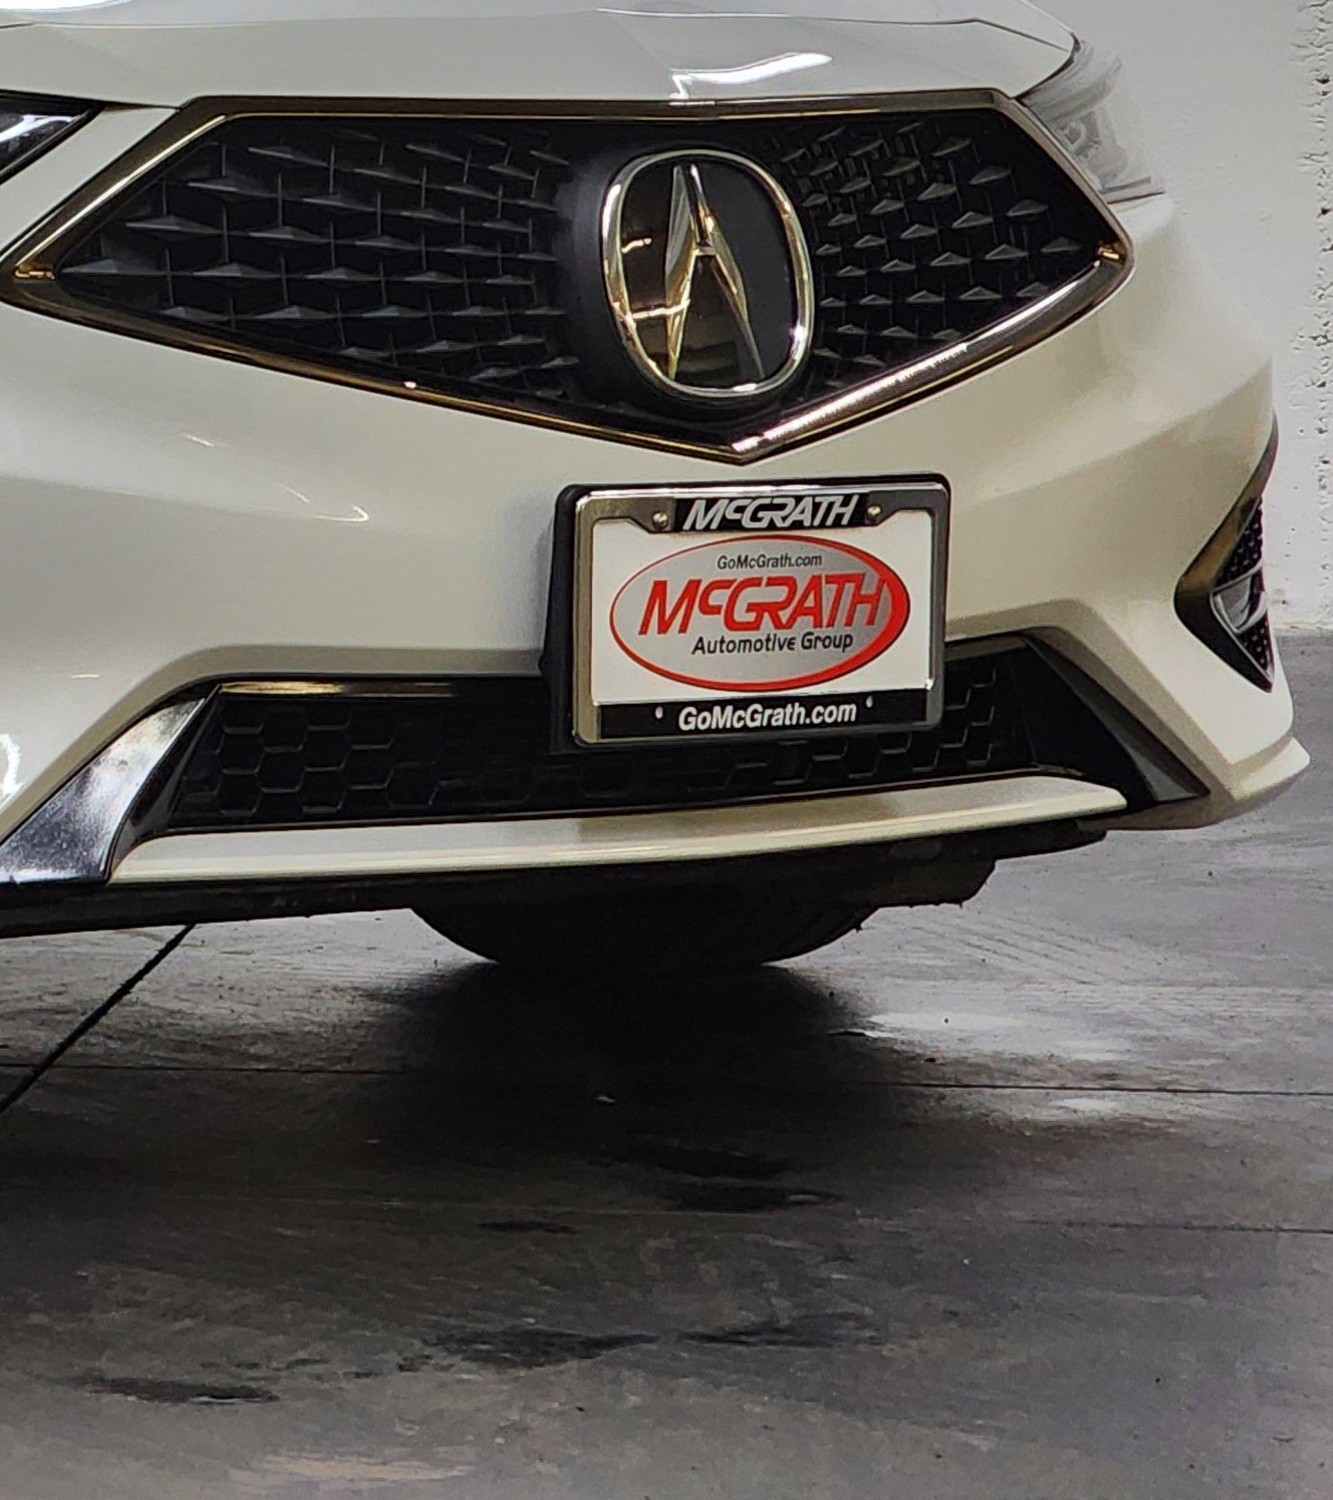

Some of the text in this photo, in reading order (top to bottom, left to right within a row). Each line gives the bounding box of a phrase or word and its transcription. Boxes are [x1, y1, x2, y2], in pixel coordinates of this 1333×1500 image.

[717, 553, 822, 570] GoMcGrath.com
[691, 631, 854, 655] Automotive Group
[678, 703, 857, 732] GoMcGrath.com
